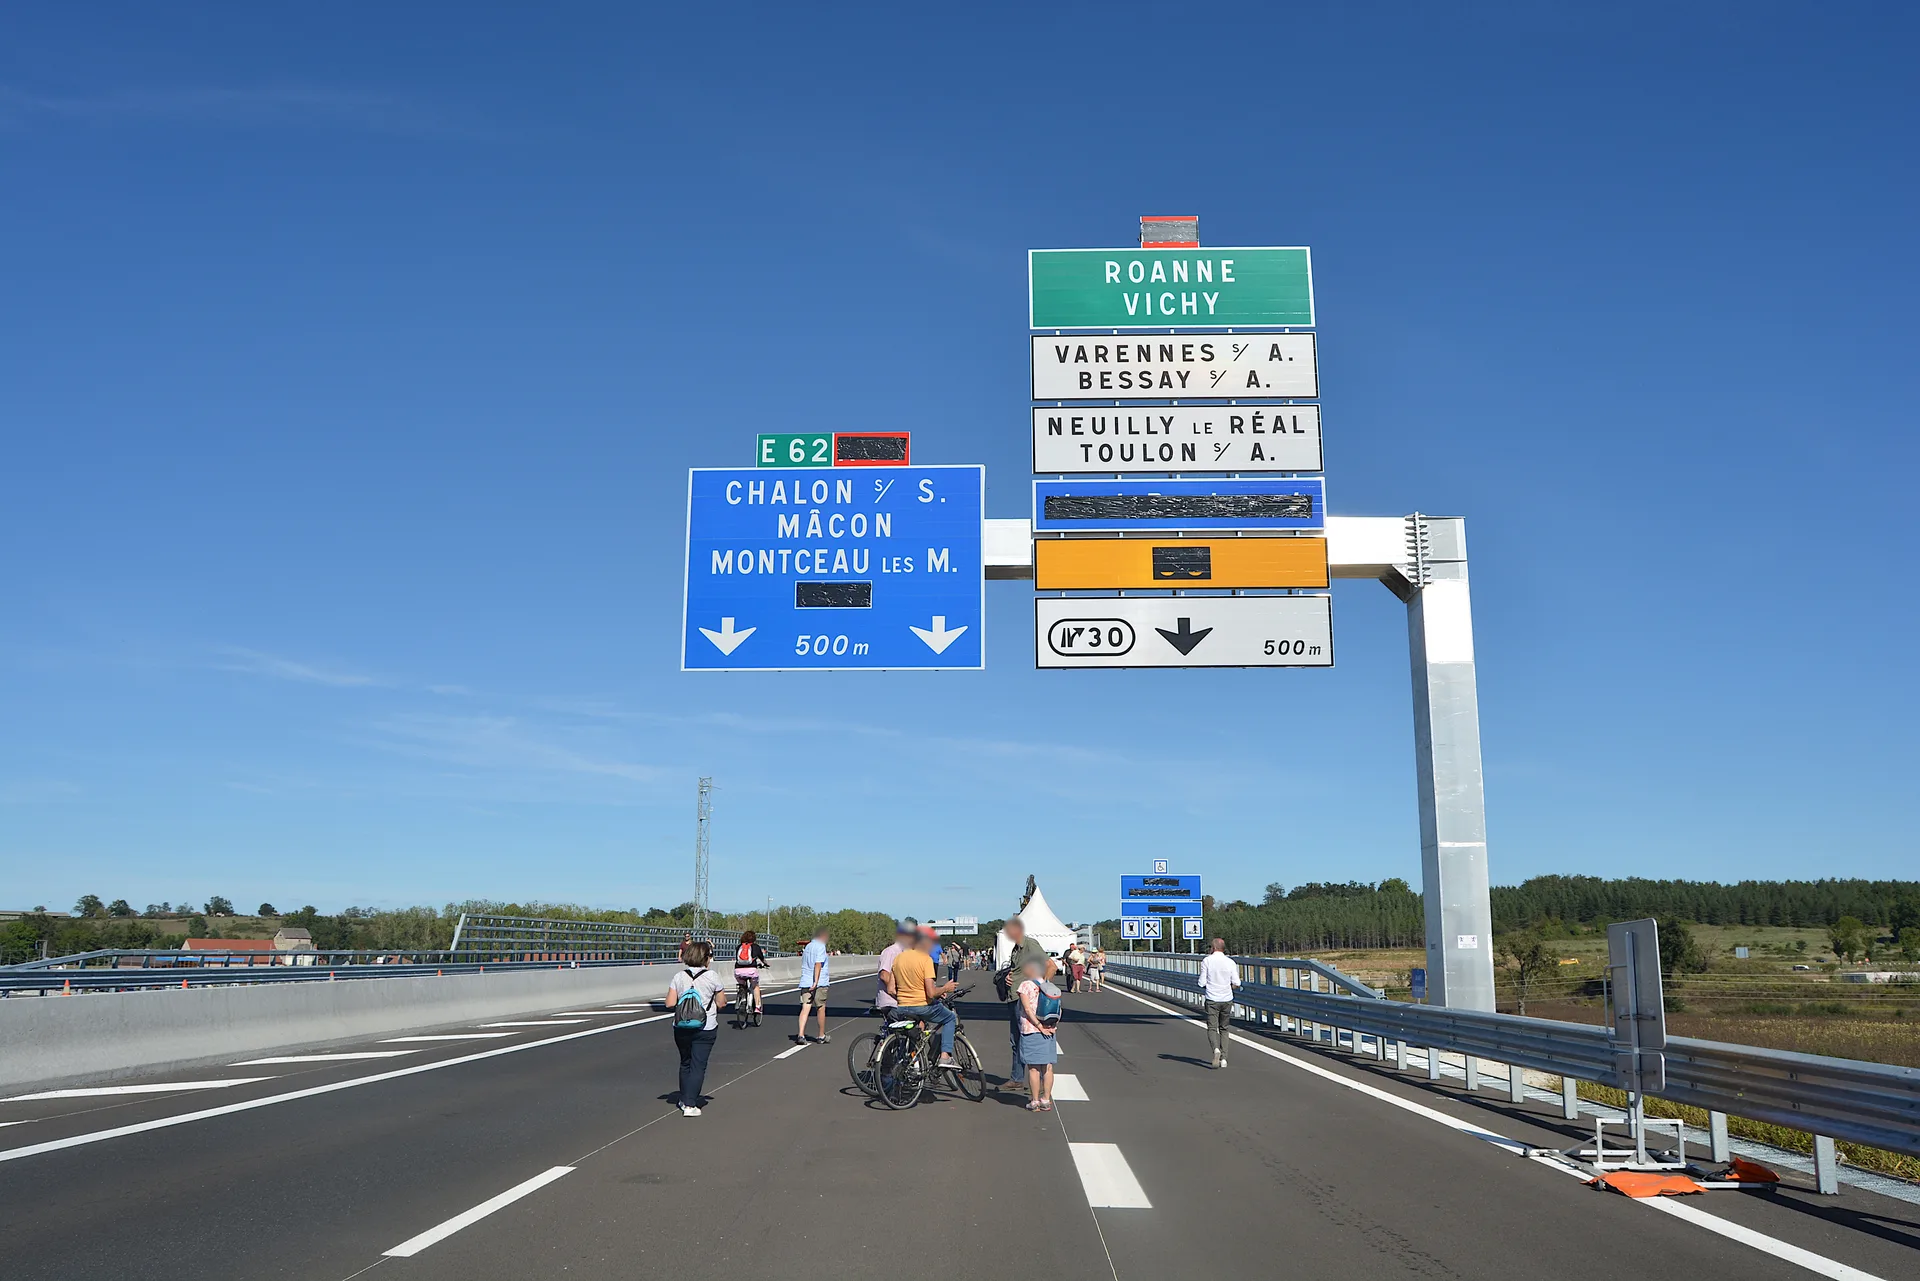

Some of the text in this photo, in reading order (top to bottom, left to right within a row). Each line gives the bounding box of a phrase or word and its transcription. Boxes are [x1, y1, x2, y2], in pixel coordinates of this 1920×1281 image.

[1105, 259, 1236, 284] ROANNE
[1123, 291, 1220, 316] VICHY
[1054, 343, 1215, 364] VARENNES
[1268, 343, 1294, 362] A.
[1079, 370, 1191, 390] BESSAY
[1246, 369, 1271, 389] A.
[1047, 410, 1305, 436] NEUILLY LE RÉAL
[761, 438, 828, 463] E 62
[1079, 442, 1196, 463] TOULON
[1250, 442, 1275, 462] A.
[726, 479, 852, 505] CHALON
[917, 478, 946, 503] S.
[777, 508, 891, 539] MÂCON
[711, 547, 958, 575] MONTCEAU LES M.
[1088, 626, 1124, 648] 30
